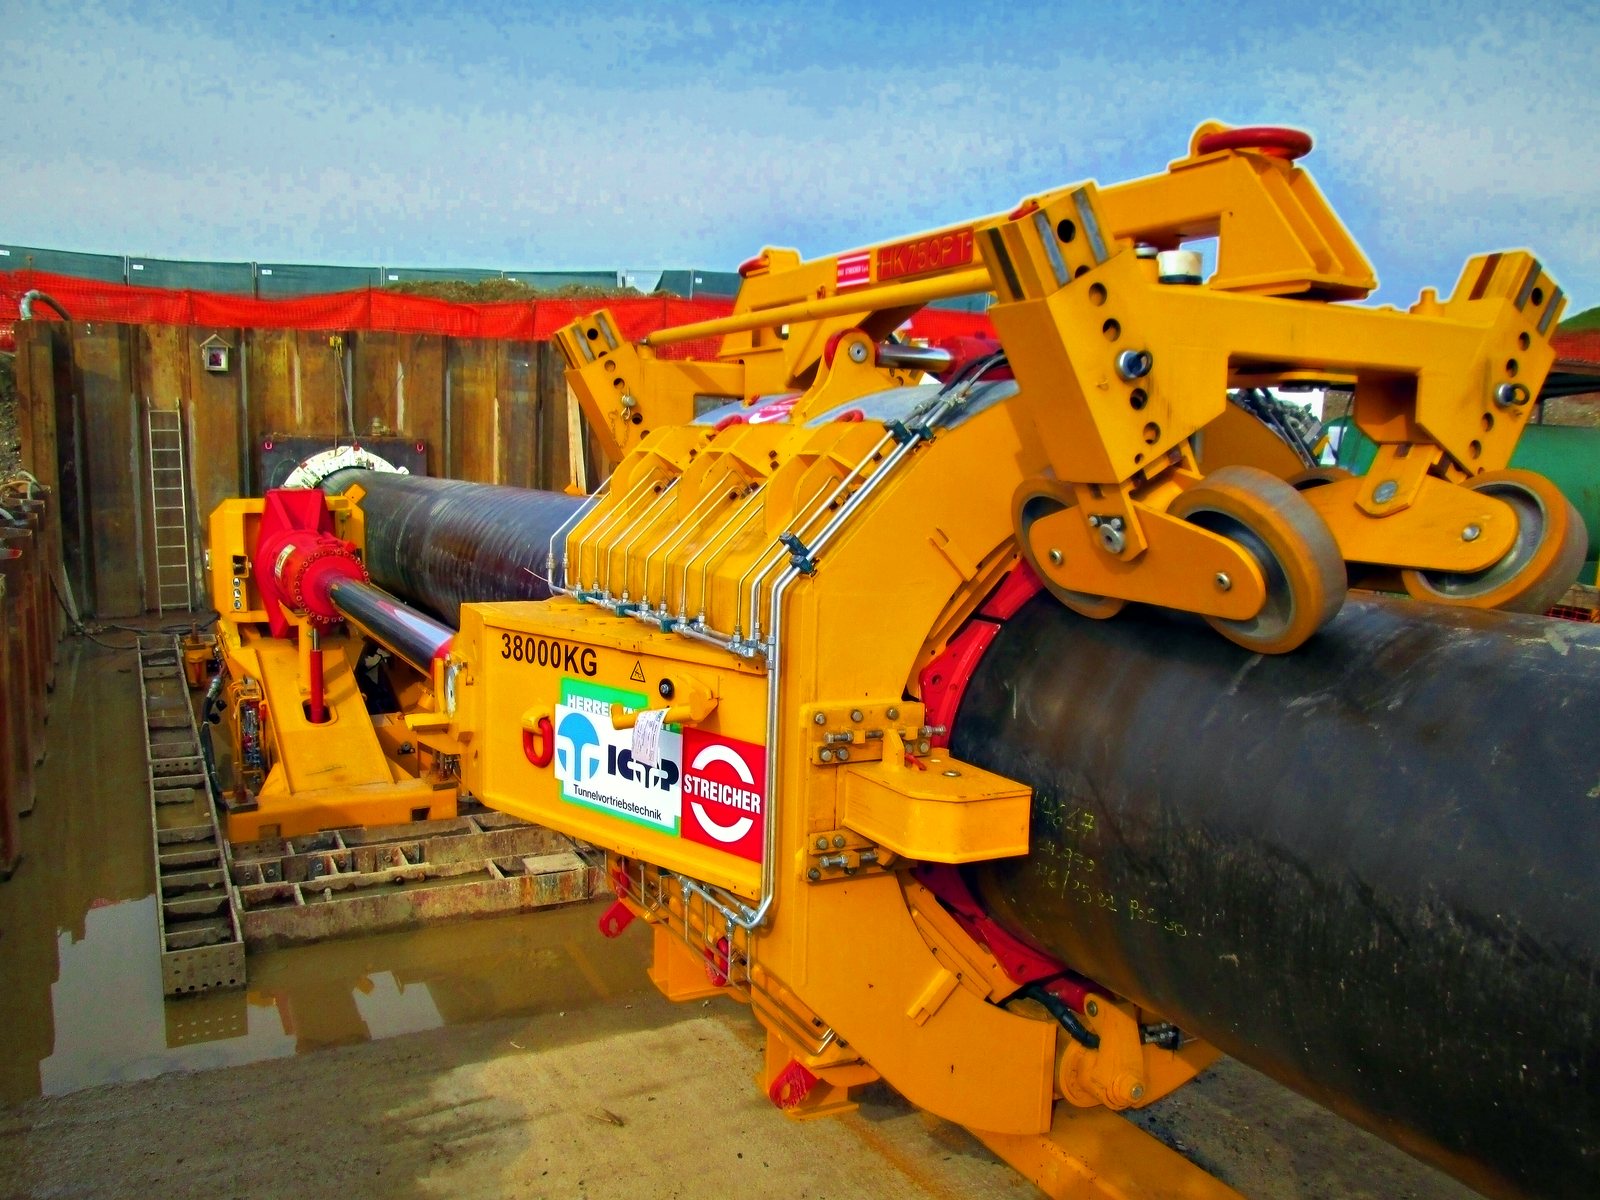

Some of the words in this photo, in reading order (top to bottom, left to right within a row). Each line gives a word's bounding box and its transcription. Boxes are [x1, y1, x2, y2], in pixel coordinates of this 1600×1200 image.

[501, 633, 597, 676] 38000KG
[573, 783, 662, 822] Tunnelvortriebstechnik
[683, 773, 761, 815] STREICHER
